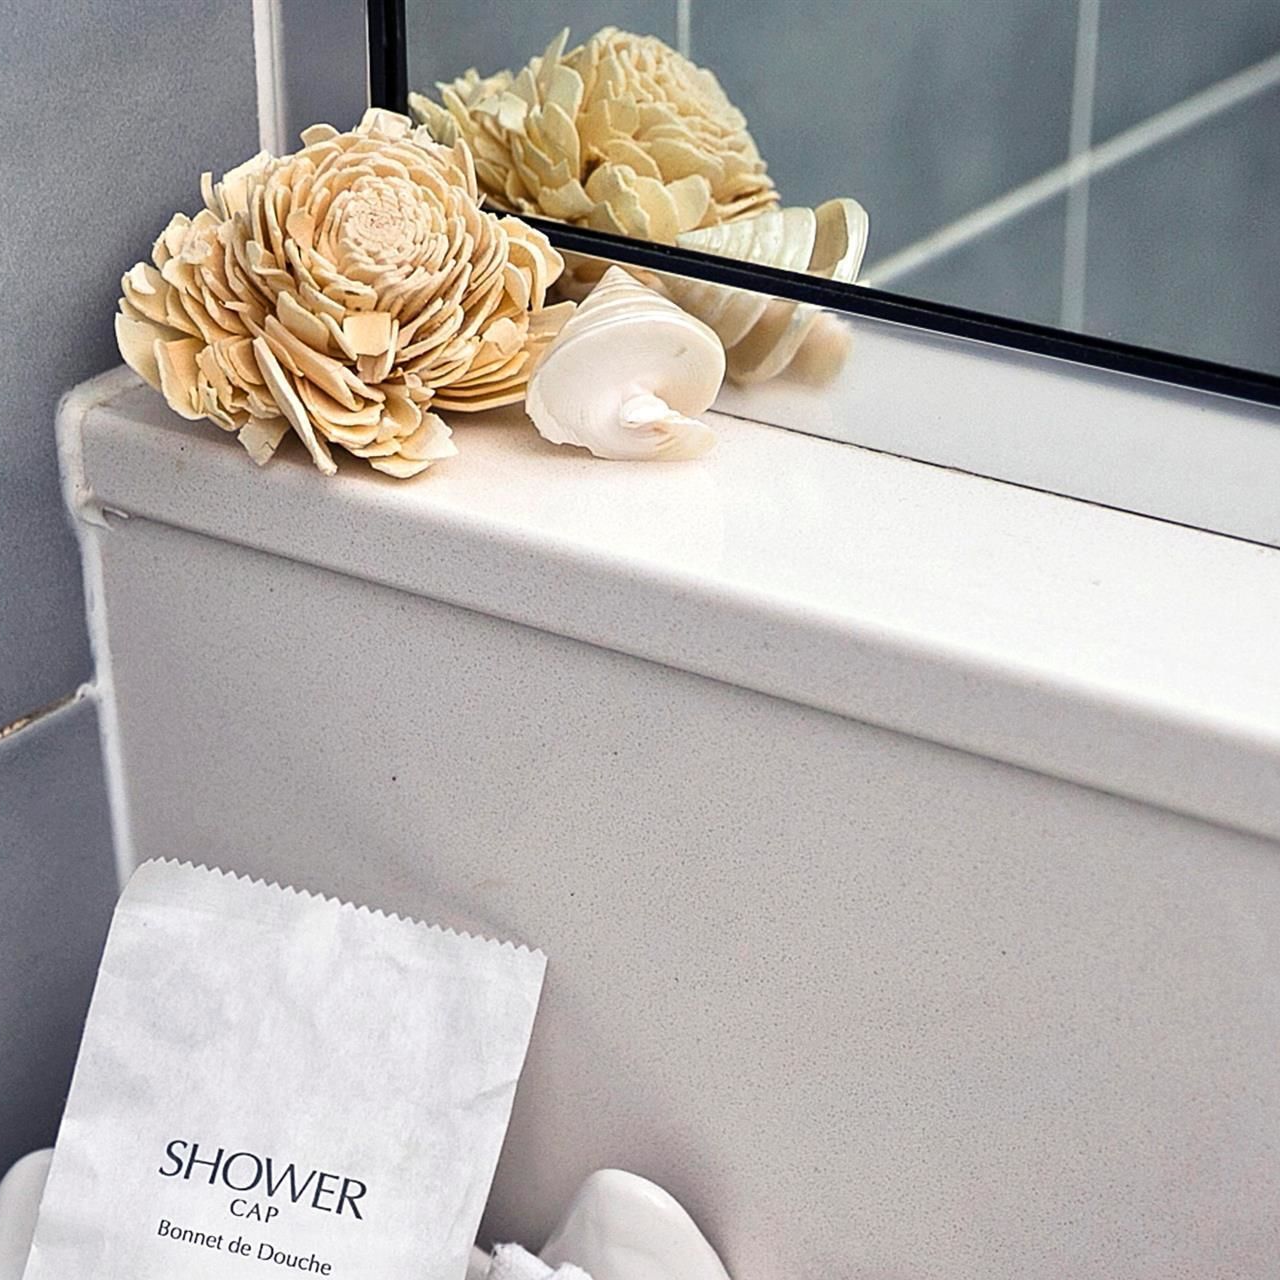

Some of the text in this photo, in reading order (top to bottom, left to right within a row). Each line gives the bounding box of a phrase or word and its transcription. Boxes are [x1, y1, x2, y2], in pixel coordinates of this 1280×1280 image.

[158, 1139, 367, 1221] SHOWER
[229, 1198, 280, 1224] CAP
[157, 1219, 332, 1276] Bonnet de Douche
